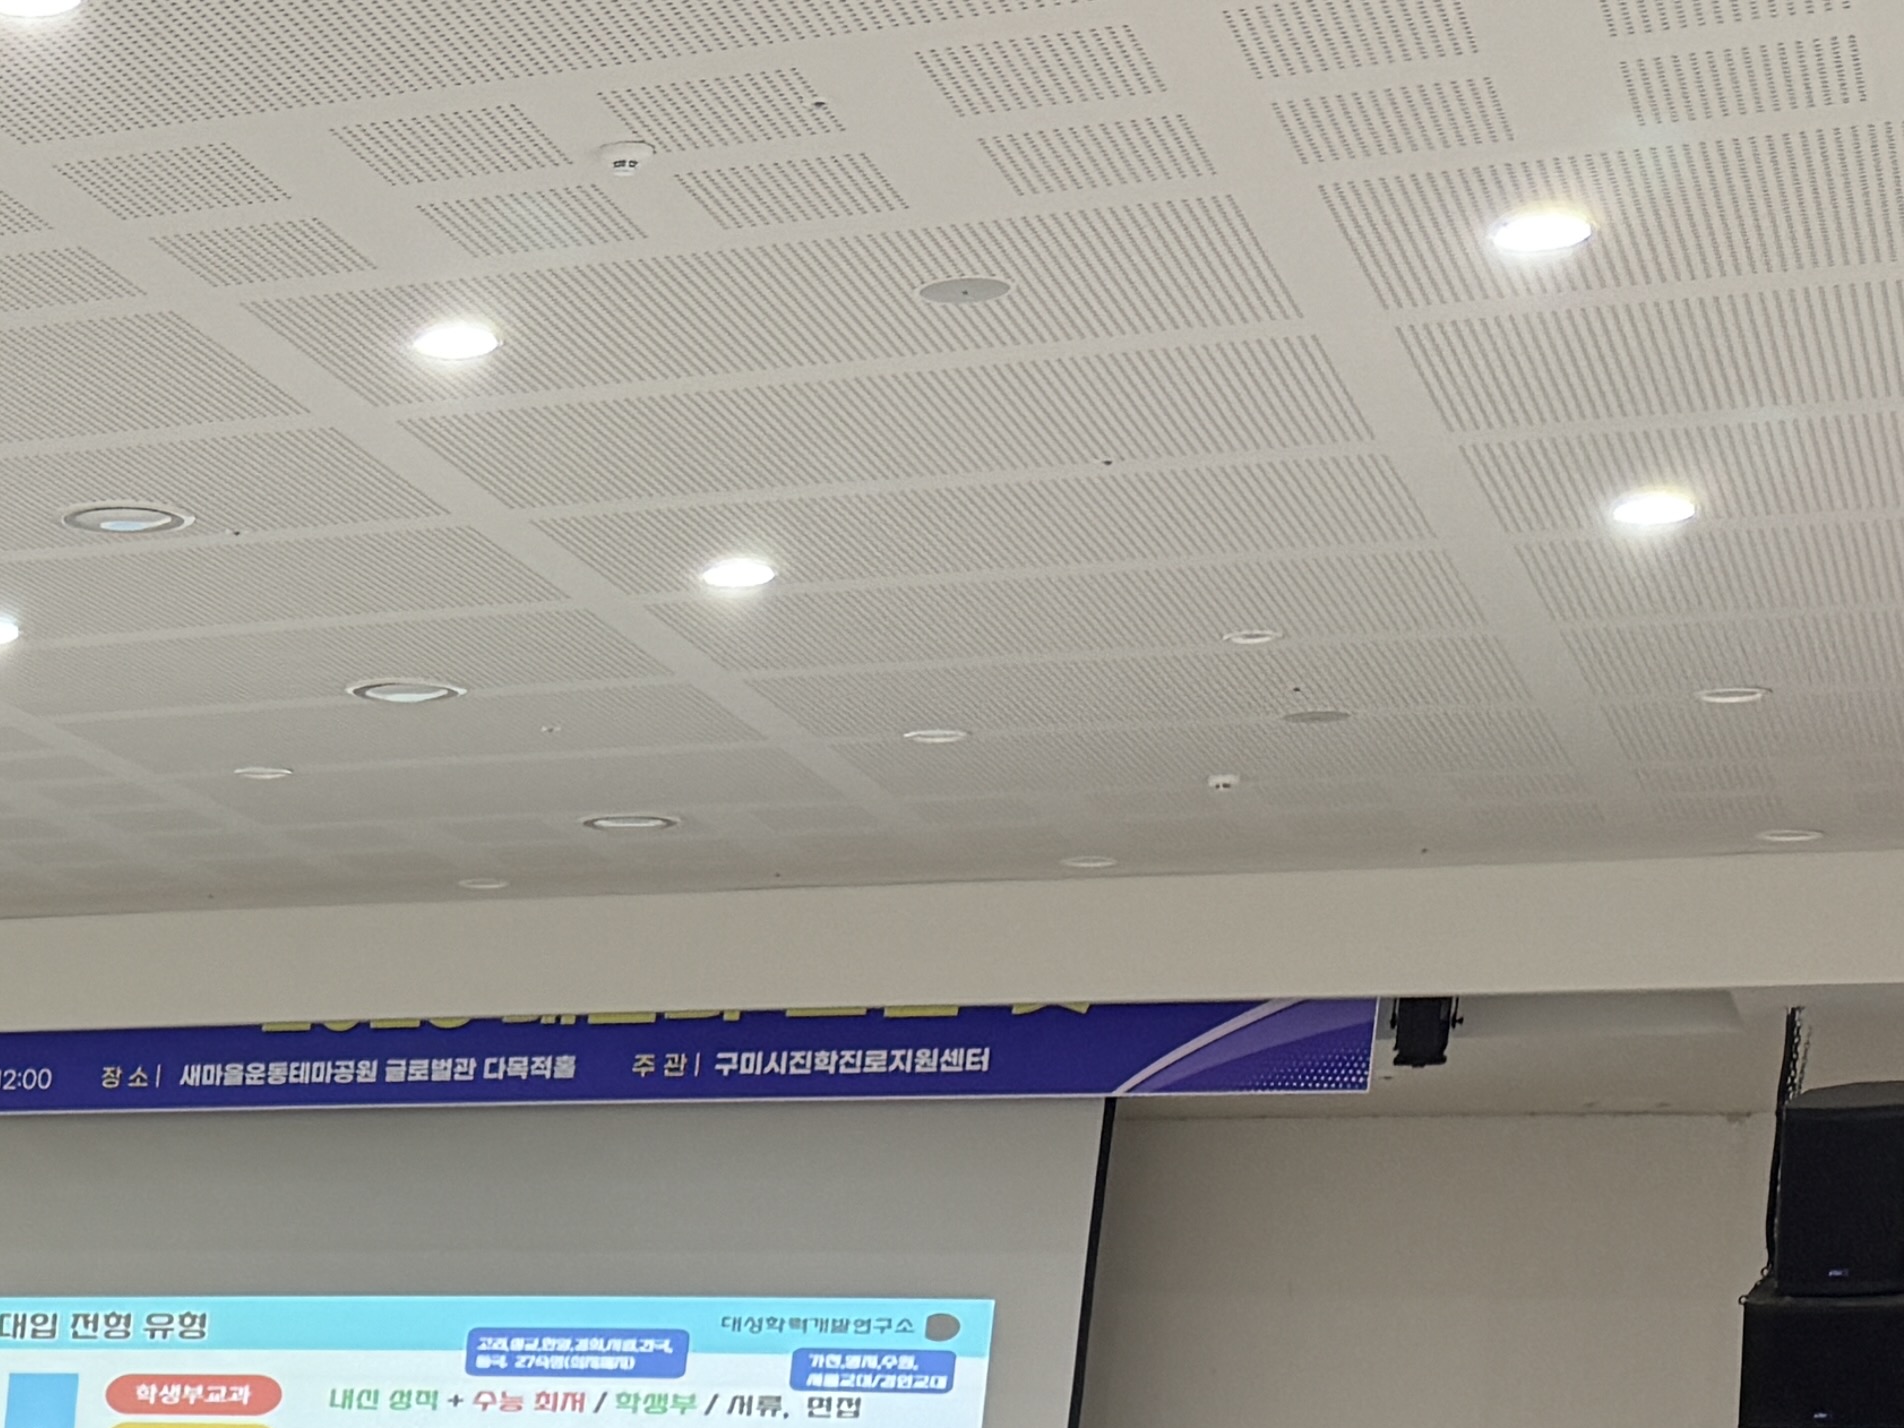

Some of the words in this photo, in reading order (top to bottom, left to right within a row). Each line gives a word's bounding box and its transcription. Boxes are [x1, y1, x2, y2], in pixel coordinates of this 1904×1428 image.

[178, 1056, 378, 1087] 새마을운동테마공원
[384, 1056, 477, 1083] 글로벌관
[482, 1054, 577, 1081] 다목적홀
[714, 1046, 990, 1077] 구미시진학진로지원센터
[70, 1310, 132, 1341] 전형
[143, 1310, 208, 1341] 유형
[720, 1315, 916, 1336] 대성학력개발연구소
[135, 1381, 252, 1406] 학생부교과
[329, 1387, 382, 1412] 내신
[388, 1388, 440, 1412] 성적
[472, 1391, 526, 1413] 수능
[533, 1390, 587, 1414] 최저
[614, 1391, 699, 1416] 학생부
[726, 1394, 791, 1420] 서류,
[806, 1396, 863, 1420] 면접
